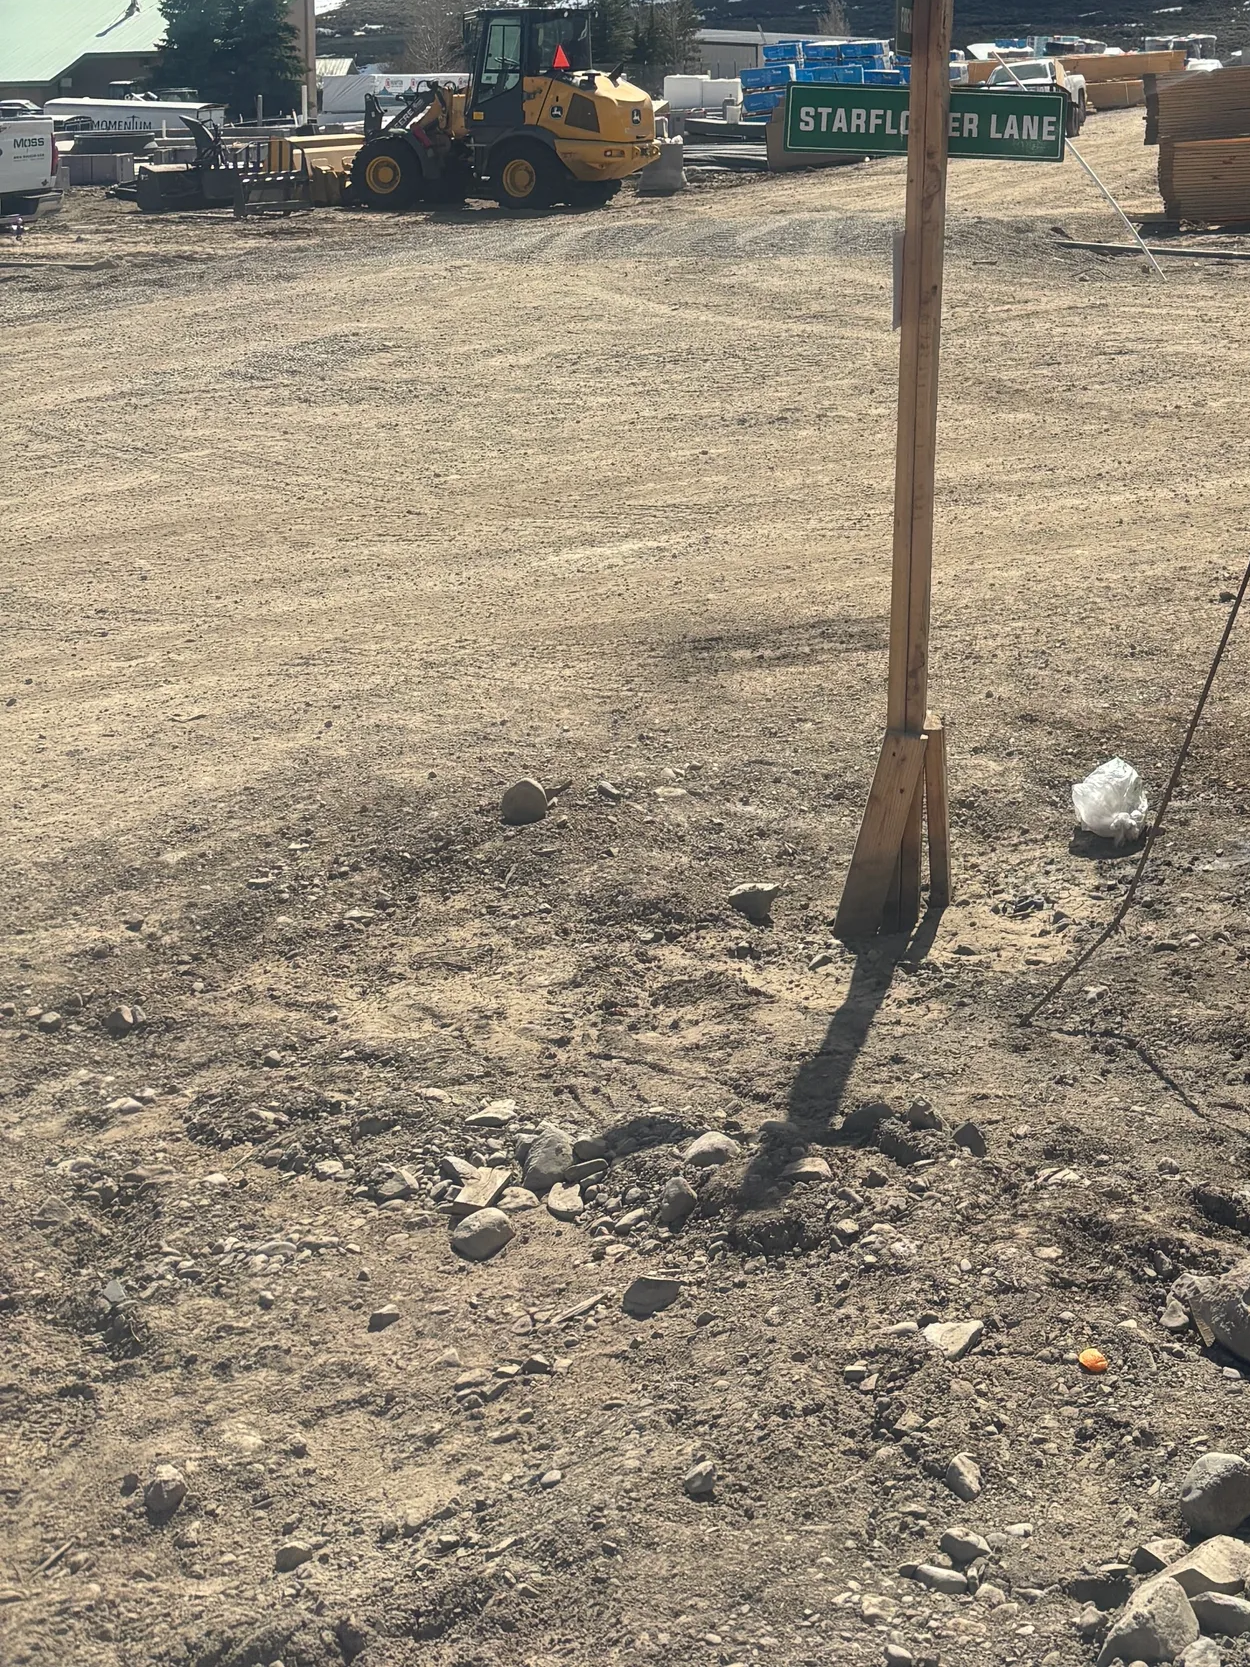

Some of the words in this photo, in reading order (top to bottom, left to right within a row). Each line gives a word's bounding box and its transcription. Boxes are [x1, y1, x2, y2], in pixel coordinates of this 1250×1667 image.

[92, 115, 152, 131] MOMENTUM
[799, 106, 979, 139] STARFLOER
[990, 114, 1057, 141] LANE
[13, 137, 45, 149] MOSS
